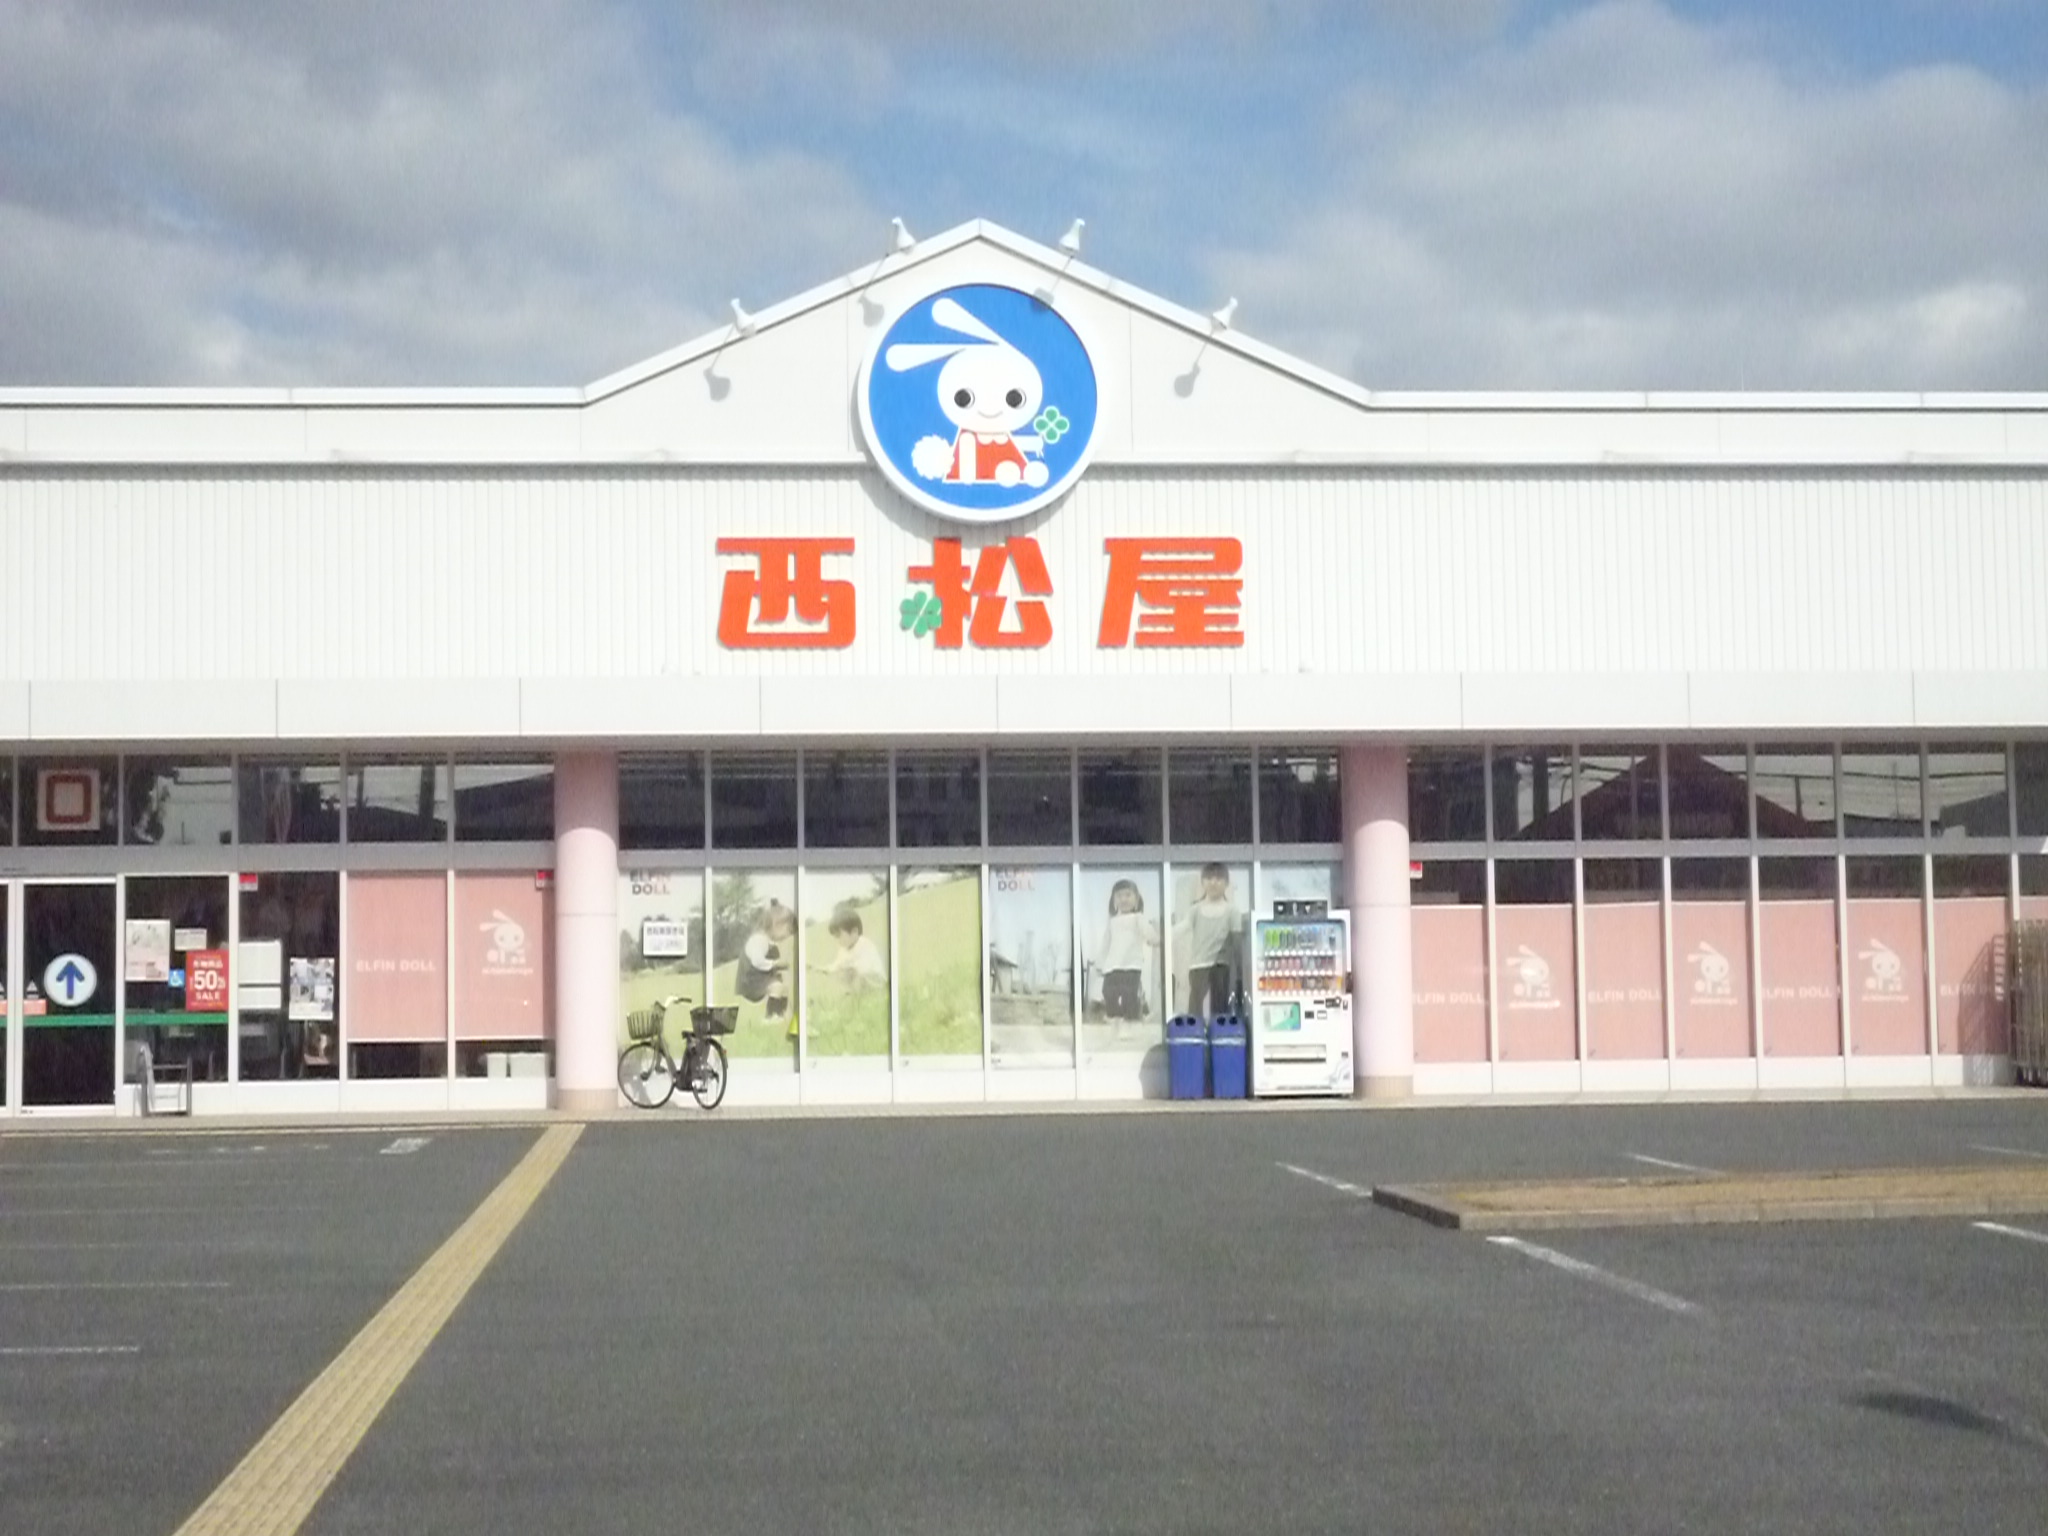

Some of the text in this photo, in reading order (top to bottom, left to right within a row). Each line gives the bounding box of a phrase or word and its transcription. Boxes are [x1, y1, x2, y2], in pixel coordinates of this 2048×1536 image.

[716, 537, 1245, 650] 西松屋
[632, 884, 670, 895] DOLL
[356, 959, 436, 972] ELFIN DOLL
[196, 991, 220, 1000] SALE
[1449, 991, 1483, 1004] DOLL
[1588, 990, 1624, 1002] ELFIN
[1799, 986, 1832, 998] DOLL
